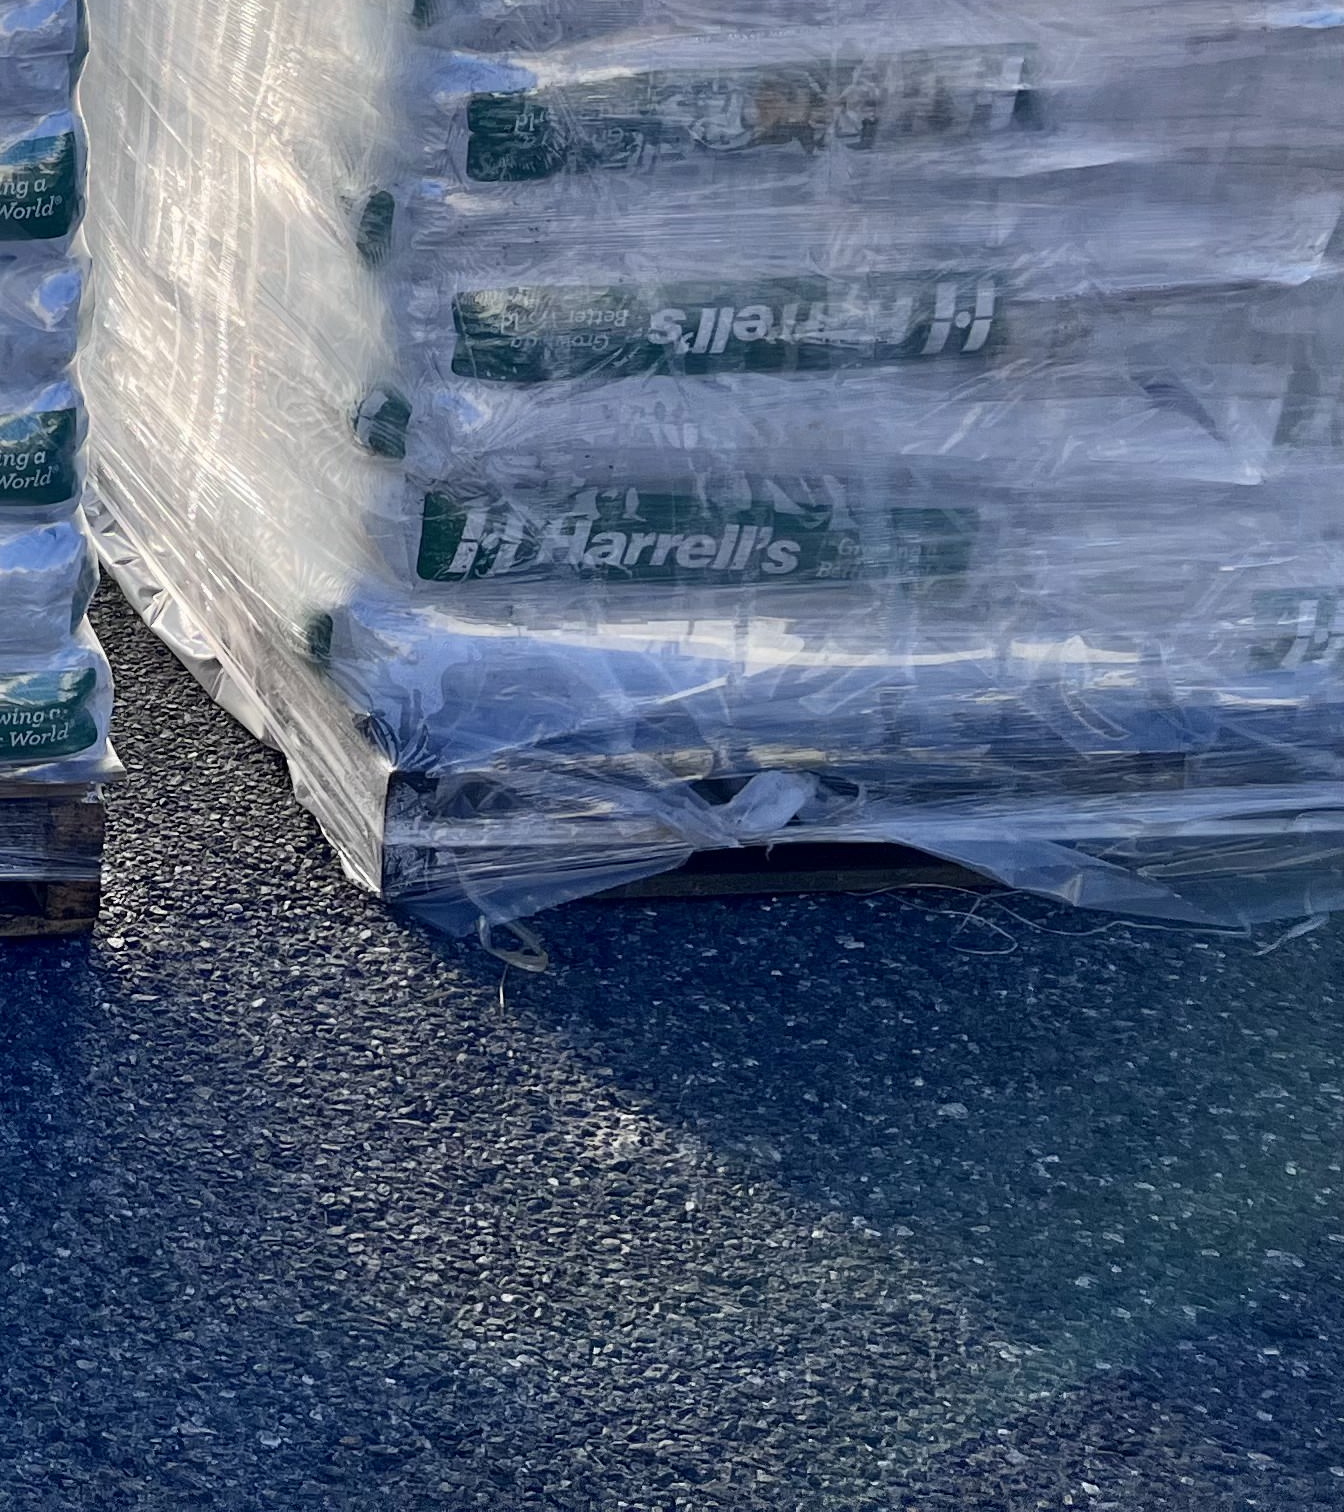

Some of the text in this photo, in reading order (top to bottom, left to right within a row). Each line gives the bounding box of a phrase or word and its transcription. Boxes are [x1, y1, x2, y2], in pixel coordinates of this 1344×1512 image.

[34, 178, 47, 192] a
[34, 451, 46, 464] a
[537, 519, 802, 575] Harrell's
